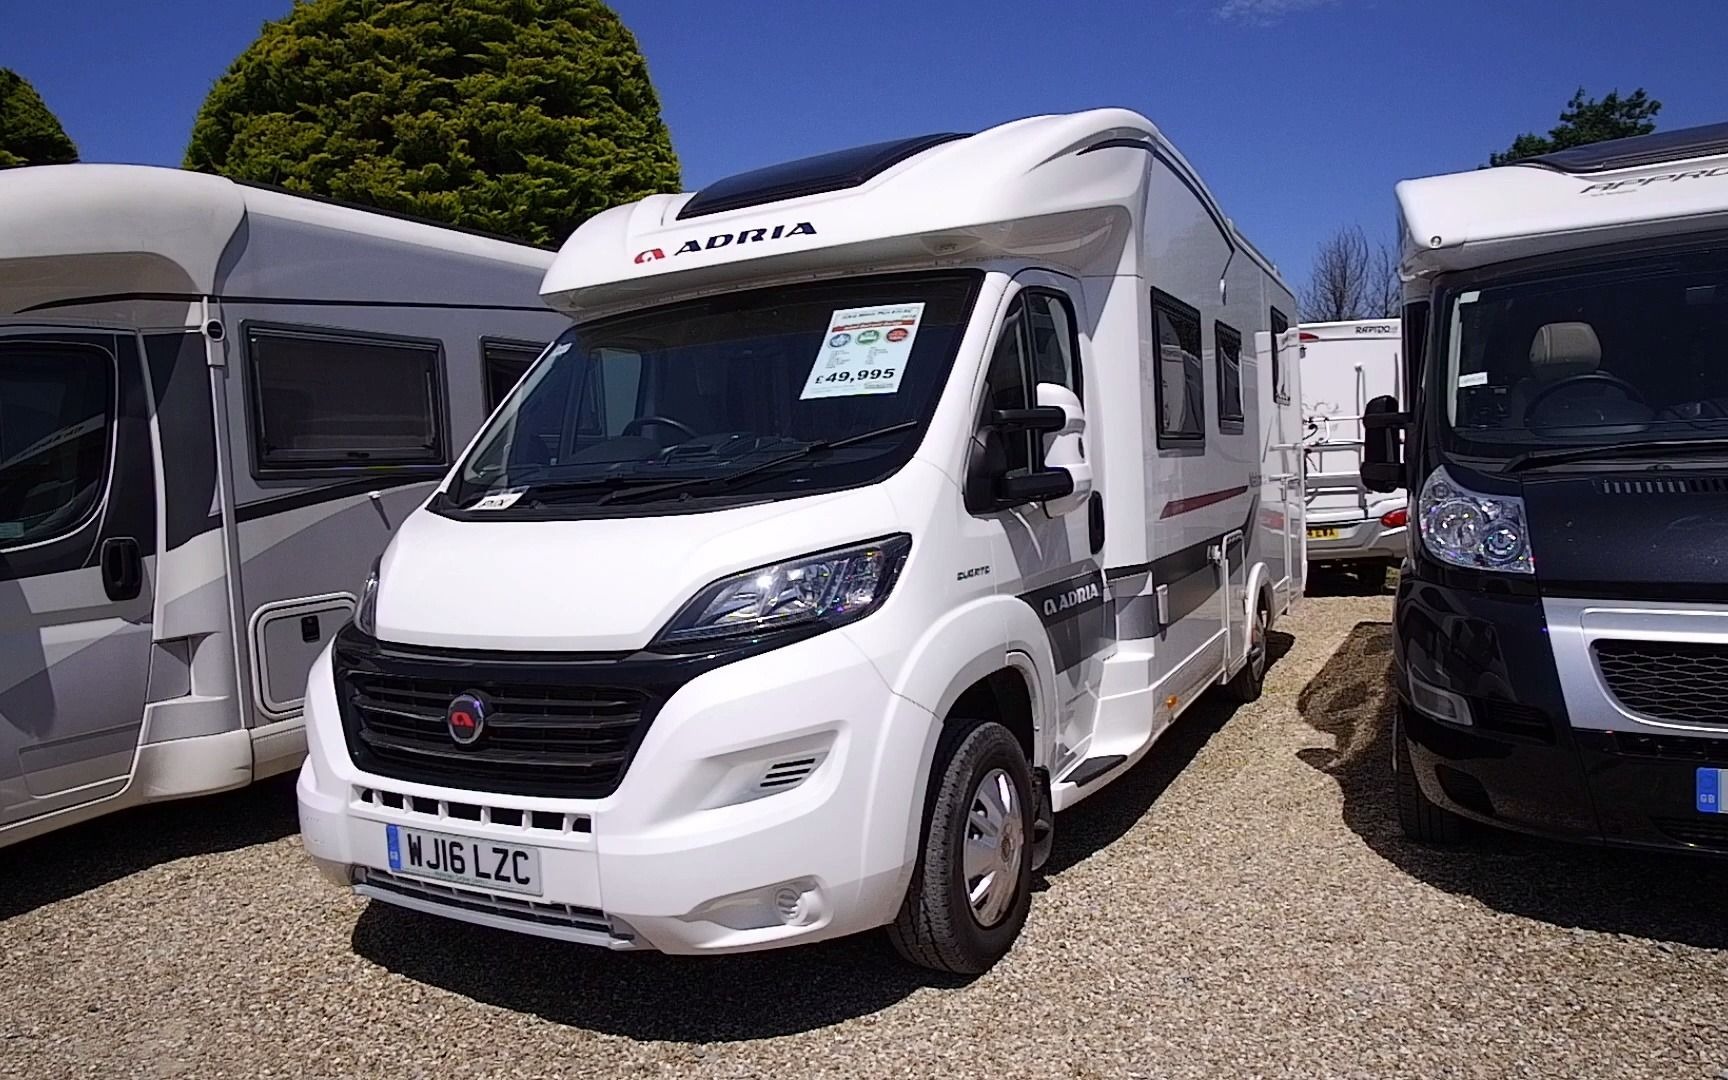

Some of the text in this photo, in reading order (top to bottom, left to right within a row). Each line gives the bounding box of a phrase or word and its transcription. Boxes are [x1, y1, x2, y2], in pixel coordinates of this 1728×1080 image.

[674, 222, 817, 256] ADRIA
[815, 368, 896, 384] £49,995
[1059, 582, 1099, 611] ADRIA
[1700, 794, 1715, 804] GB
[407, 833, 530, 885] WJ16 LZC
